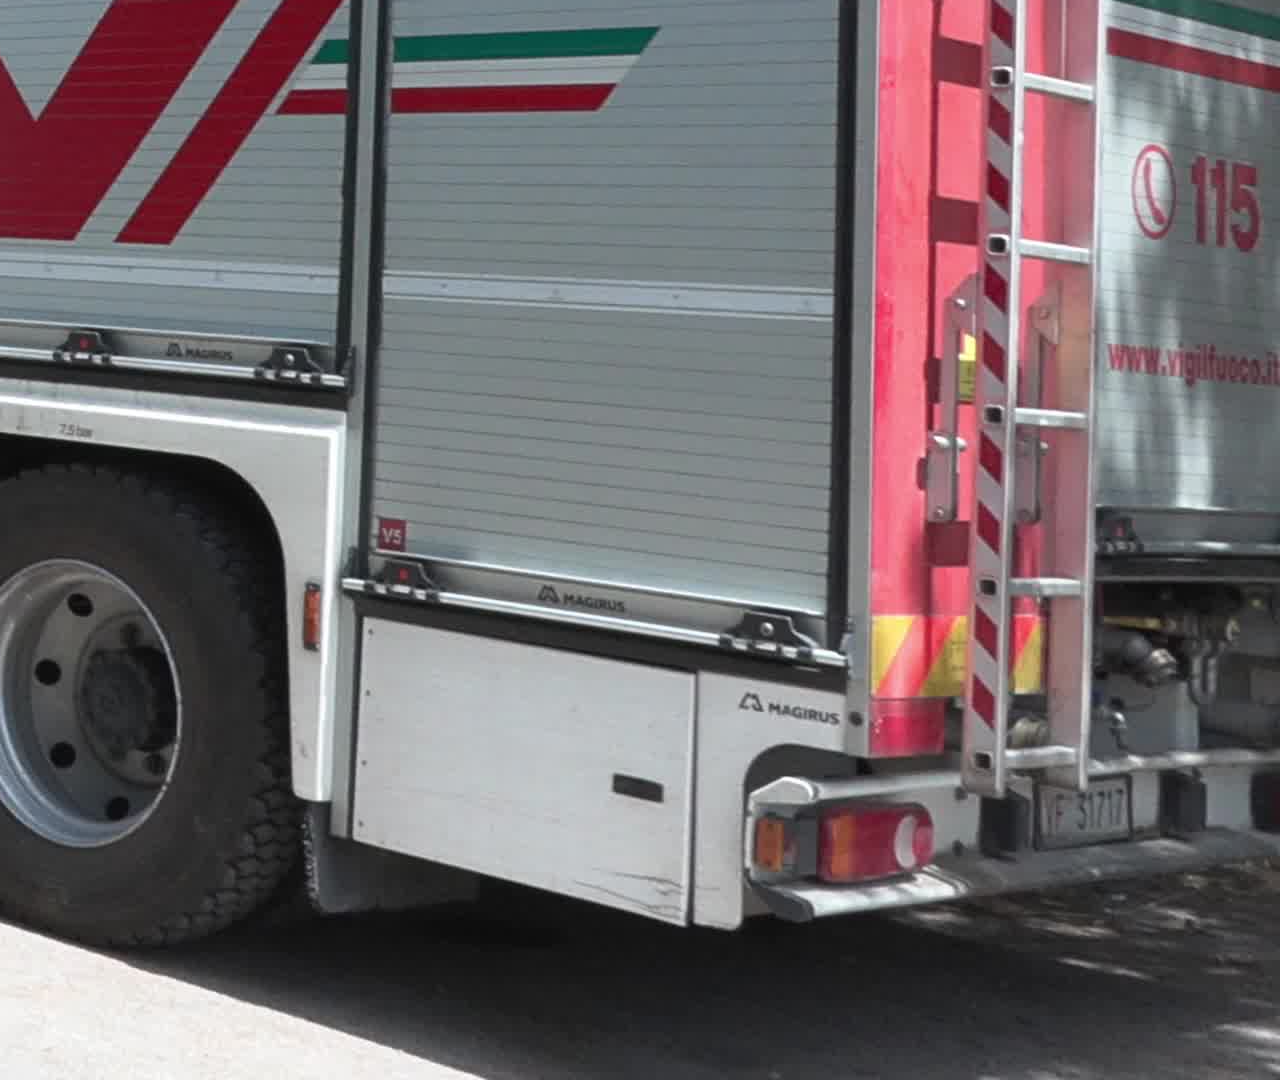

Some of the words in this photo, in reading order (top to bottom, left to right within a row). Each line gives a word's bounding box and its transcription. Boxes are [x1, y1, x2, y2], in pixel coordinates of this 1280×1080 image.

[1191, 155, 1261, 253] 115
[563, 594, 625, 613] MAGIRUS
[768, 703, 840, 725] MAGIRUS
